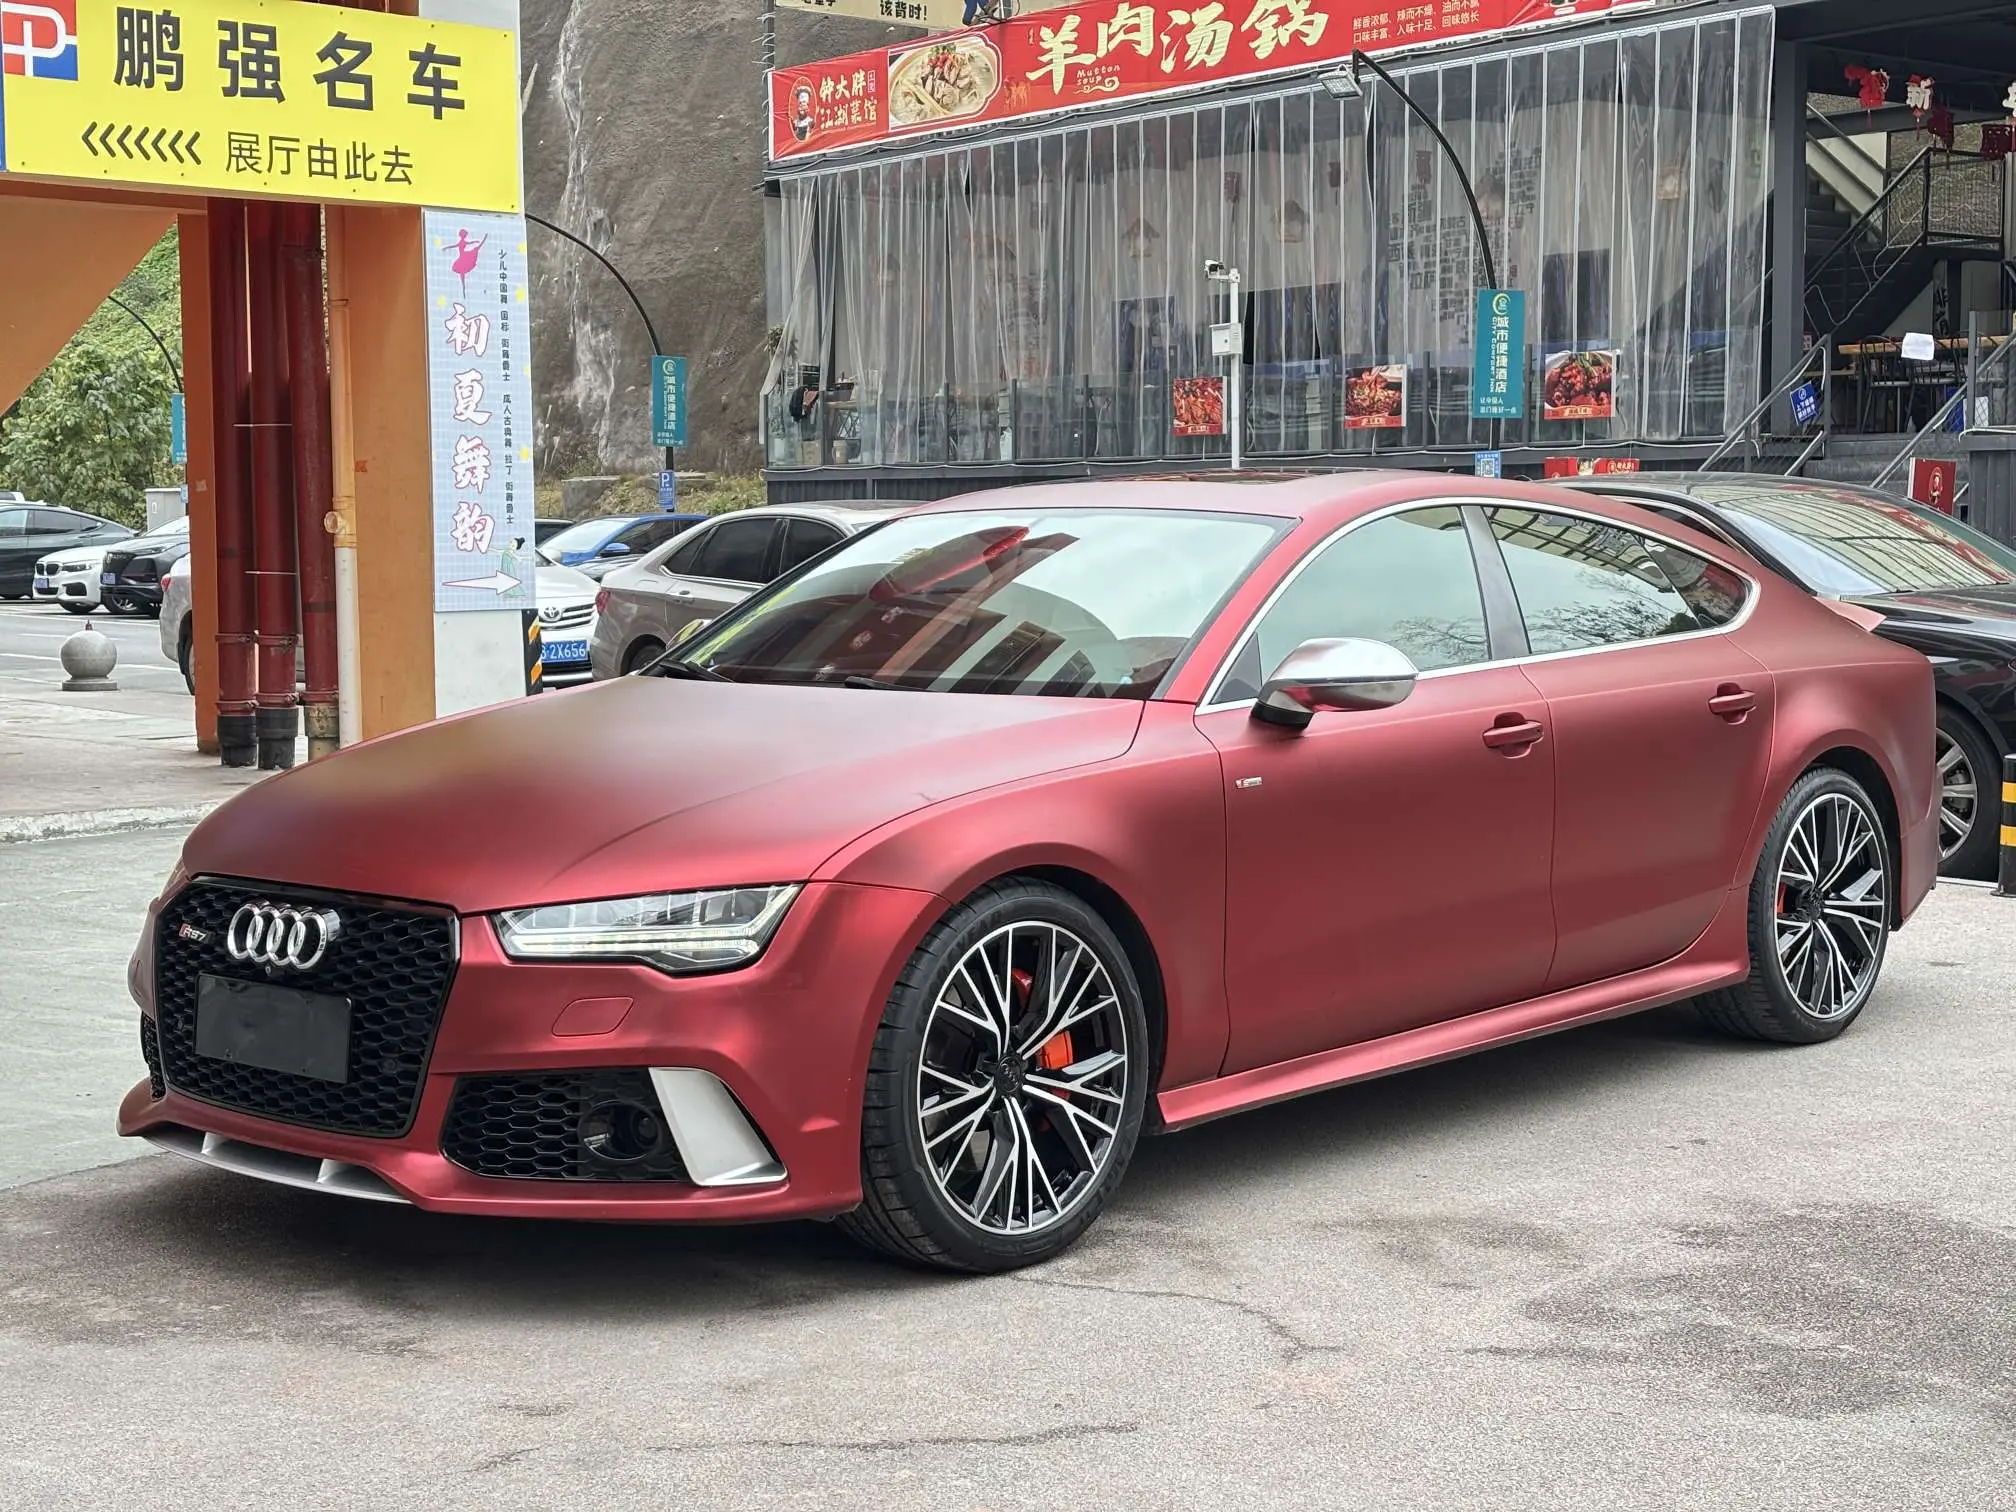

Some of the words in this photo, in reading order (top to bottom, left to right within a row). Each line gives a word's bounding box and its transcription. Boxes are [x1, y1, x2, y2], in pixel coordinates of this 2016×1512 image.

[113, 6, 466, 120] 鹏强名车
[1025, 0, 1330, 96] 羊肉汤锅
[1076, 65, 1120, 79] Mutton
[819, 69, 867, 103] 钟大胖
[820, 96, 878, 130] 江湖菜馆
[225, 131, 414, 185] 展厅由此去
[1495, 316, 1509, 393] 城市便捷酒店
[444, 302, 496, 554] 初夏舞韵
[179, 923, 207, 942] RS7
